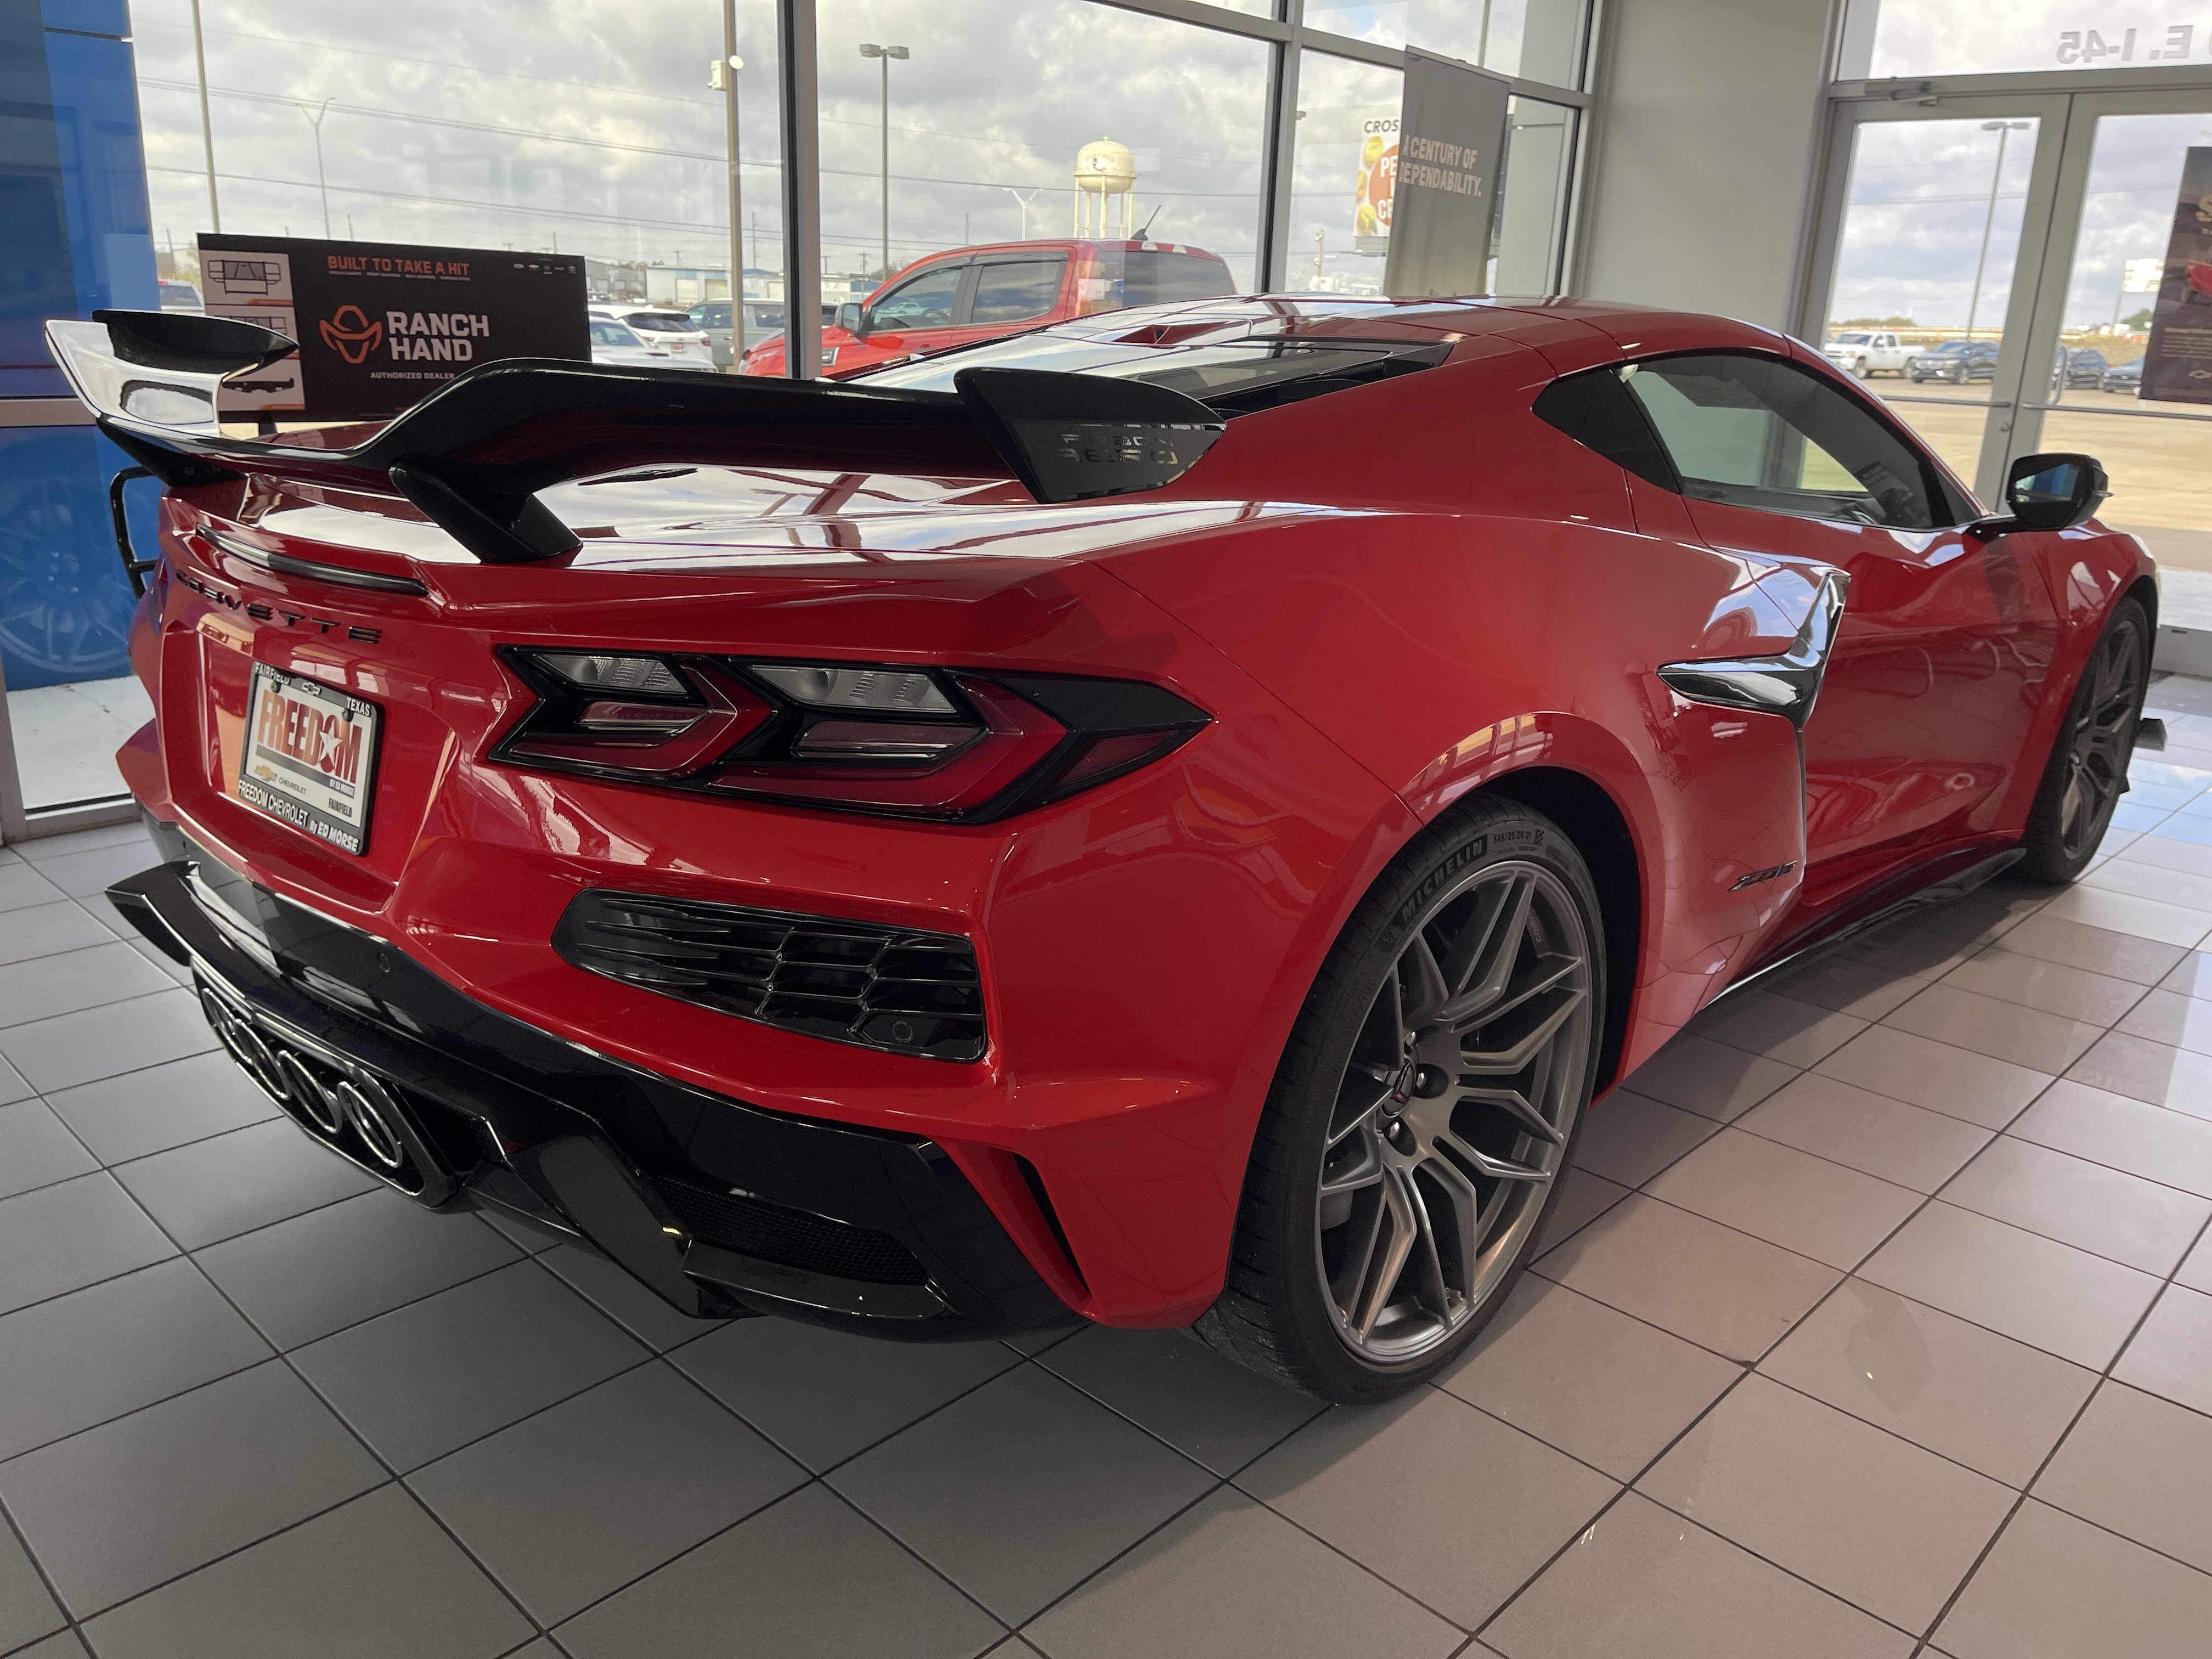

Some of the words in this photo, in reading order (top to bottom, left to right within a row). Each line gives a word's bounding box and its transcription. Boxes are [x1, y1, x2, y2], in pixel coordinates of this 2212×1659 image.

[1364, 119, 1400, 133] CROS
[1402, 134, 1409, 156] A
[1410, 136, 1463, 167] CENTURY
[1463, 148, 1478, 170] OF
[328, 255, 368, 270] BUILT
[371, 258, 392, 272] TO
[394, 259, 432, 274] TAKE
[436, 262, 445, 274] A
[447, 262, 470, 275] HIT
[386, 311, 490, 337] RANCH
[388, 337, 473, 362] HAND
[176, 569, 383, 645] CORVETTE
[347, 697, 371, 718] TEXAS
[279, 777, 307, 794] CHEVROLET
[238, 779, 269, 806] FREEDOM
[268, 795, 309, 826] CHEVROLET
[317, 821, 329, 838] ED
[329, 827, 359, 853] MORSE
[1401, 837, 1482, 923] MICHELIN
